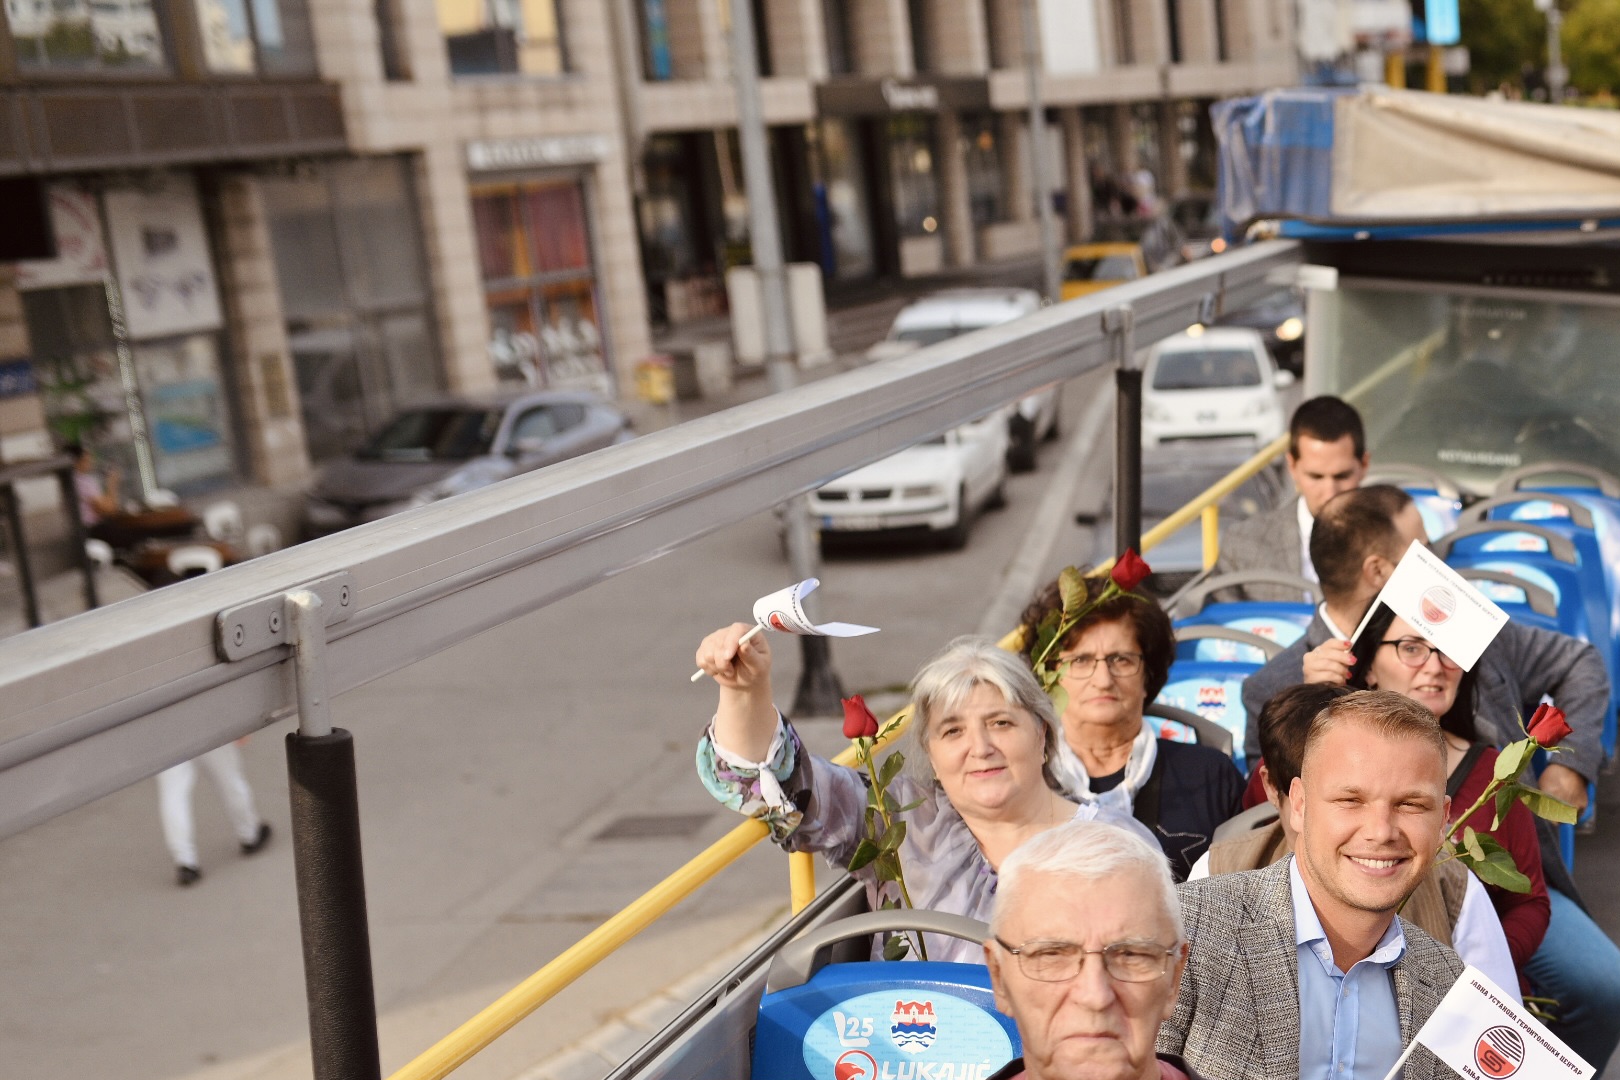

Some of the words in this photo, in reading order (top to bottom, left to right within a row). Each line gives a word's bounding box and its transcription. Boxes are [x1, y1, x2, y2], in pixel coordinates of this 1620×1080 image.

[846, 1017, 874, 1038] 25
[1470, 979, 1489, 997] ЈАВНА
[1488, 994, 1517, 1021] УСТАНОВА
[1516, 1018, 1561, 1058] ГЕРОНТОЛОШКИ
[1559, 1055, 1583, 1077] ЦЕНТАР
